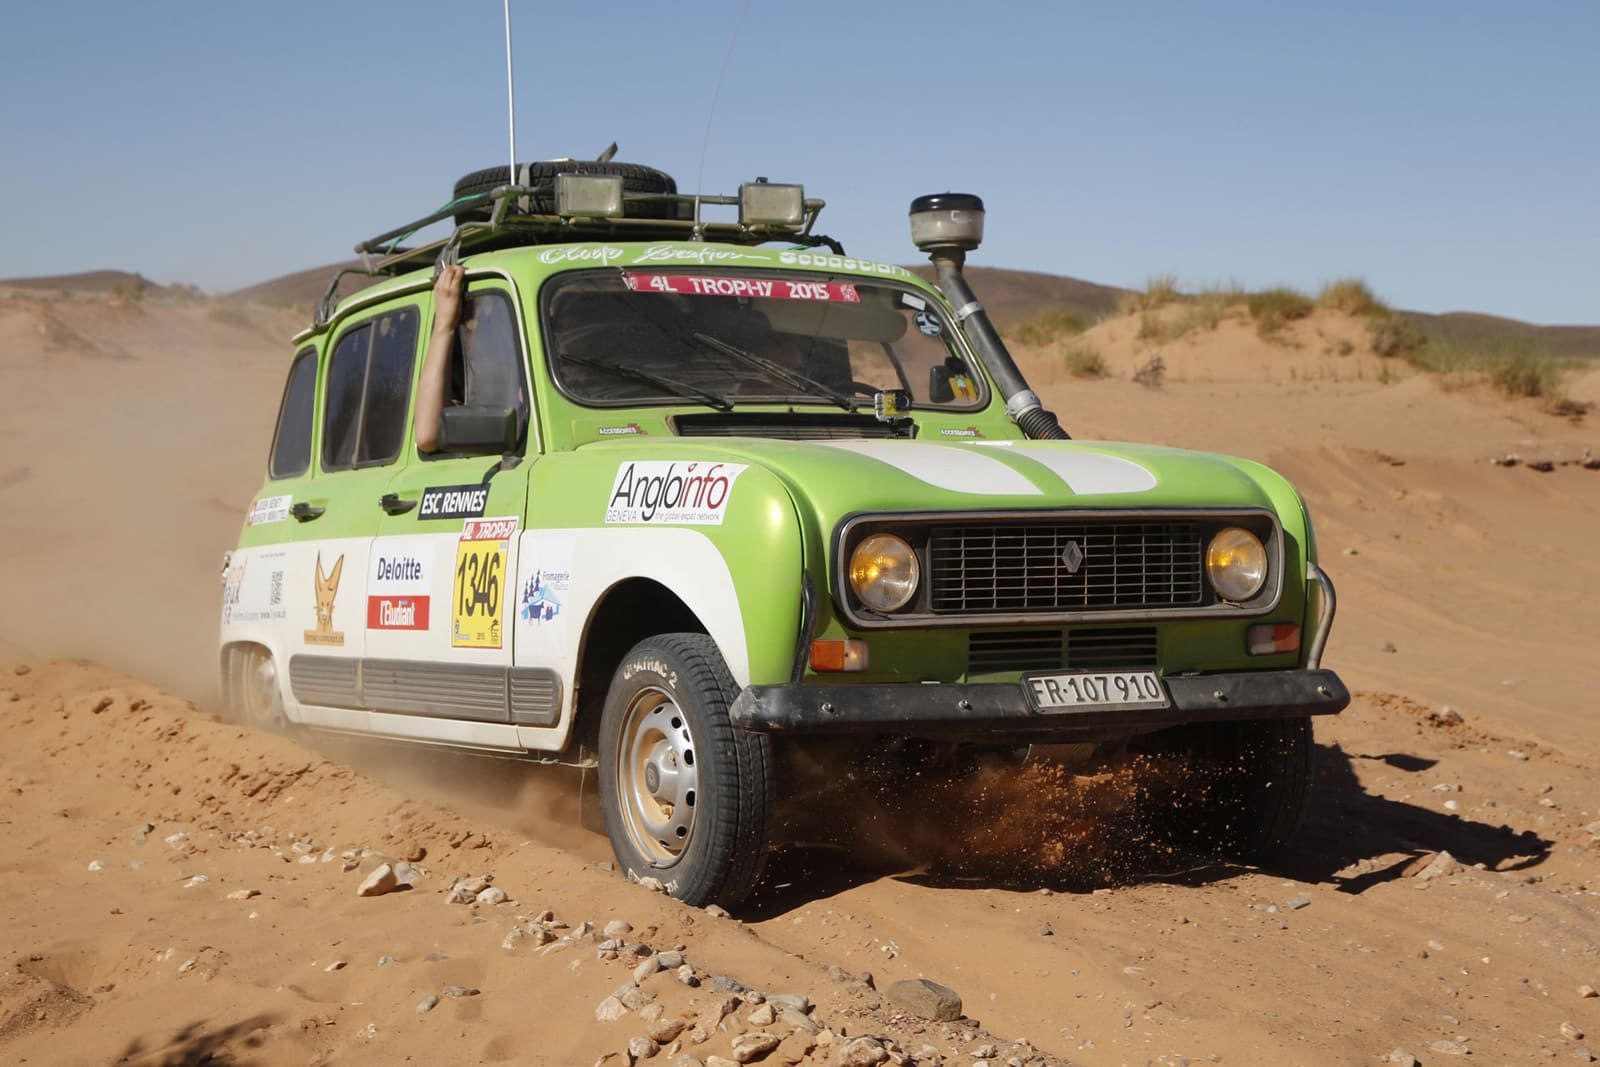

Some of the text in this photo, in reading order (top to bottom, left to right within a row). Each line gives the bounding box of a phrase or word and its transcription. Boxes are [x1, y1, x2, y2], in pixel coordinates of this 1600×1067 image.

[650, 275, 830, 300] 4L TROPHY 2015
[421, 490, 487, 514] ESC RENNES
[610, 463, 729, 521] Angloinfo
[606, 510, 637, 521] GENEVA
[476, 521, 516, 538] TROPHY
[457, 551, 500, 617] 1346
[668, 671, 678, 689] 2
